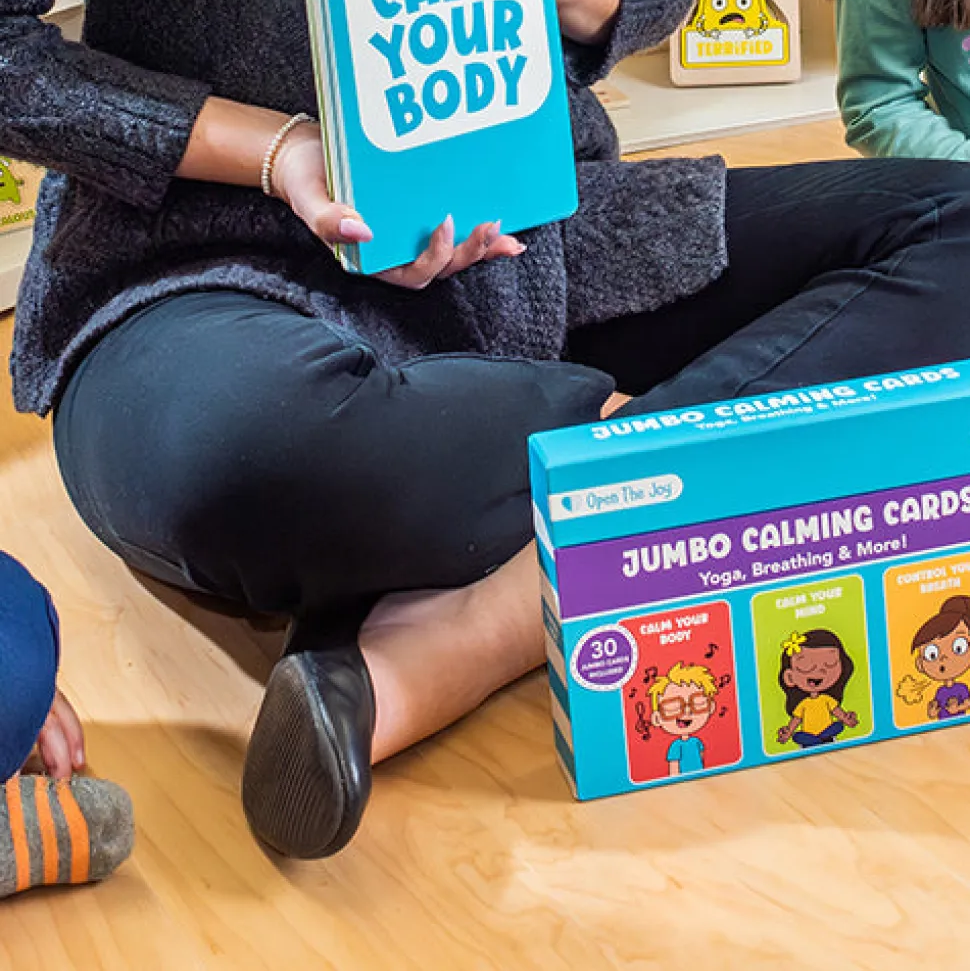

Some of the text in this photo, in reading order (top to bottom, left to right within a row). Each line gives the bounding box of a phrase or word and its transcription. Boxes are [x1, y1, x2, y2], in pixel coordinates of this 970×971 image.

[385, 54, 528, 138] BODY
[591, 367, 961, 440] JUMBO CALMING CARDS
[742, 403, 813, 423] Breathing
[585, 480, 673, 511] Open The Joy
[622, 533, 732, 578] JUMBO
[742, 505, 874, 553] CALMING
[699, 533, 908, 586] Yoga, Breathing & More!
[896, 566, 947, 586] CONTROL
[920, 577, 962, 595] BREATH
[775, 586, 844, 610] CALM YOUR
[639, 612, 710, 636] CALM YOUR
[795, 604, 826, 620] MIND
[590, 638, 618, 659] 30
[659, 630, 692, 646] BODY
